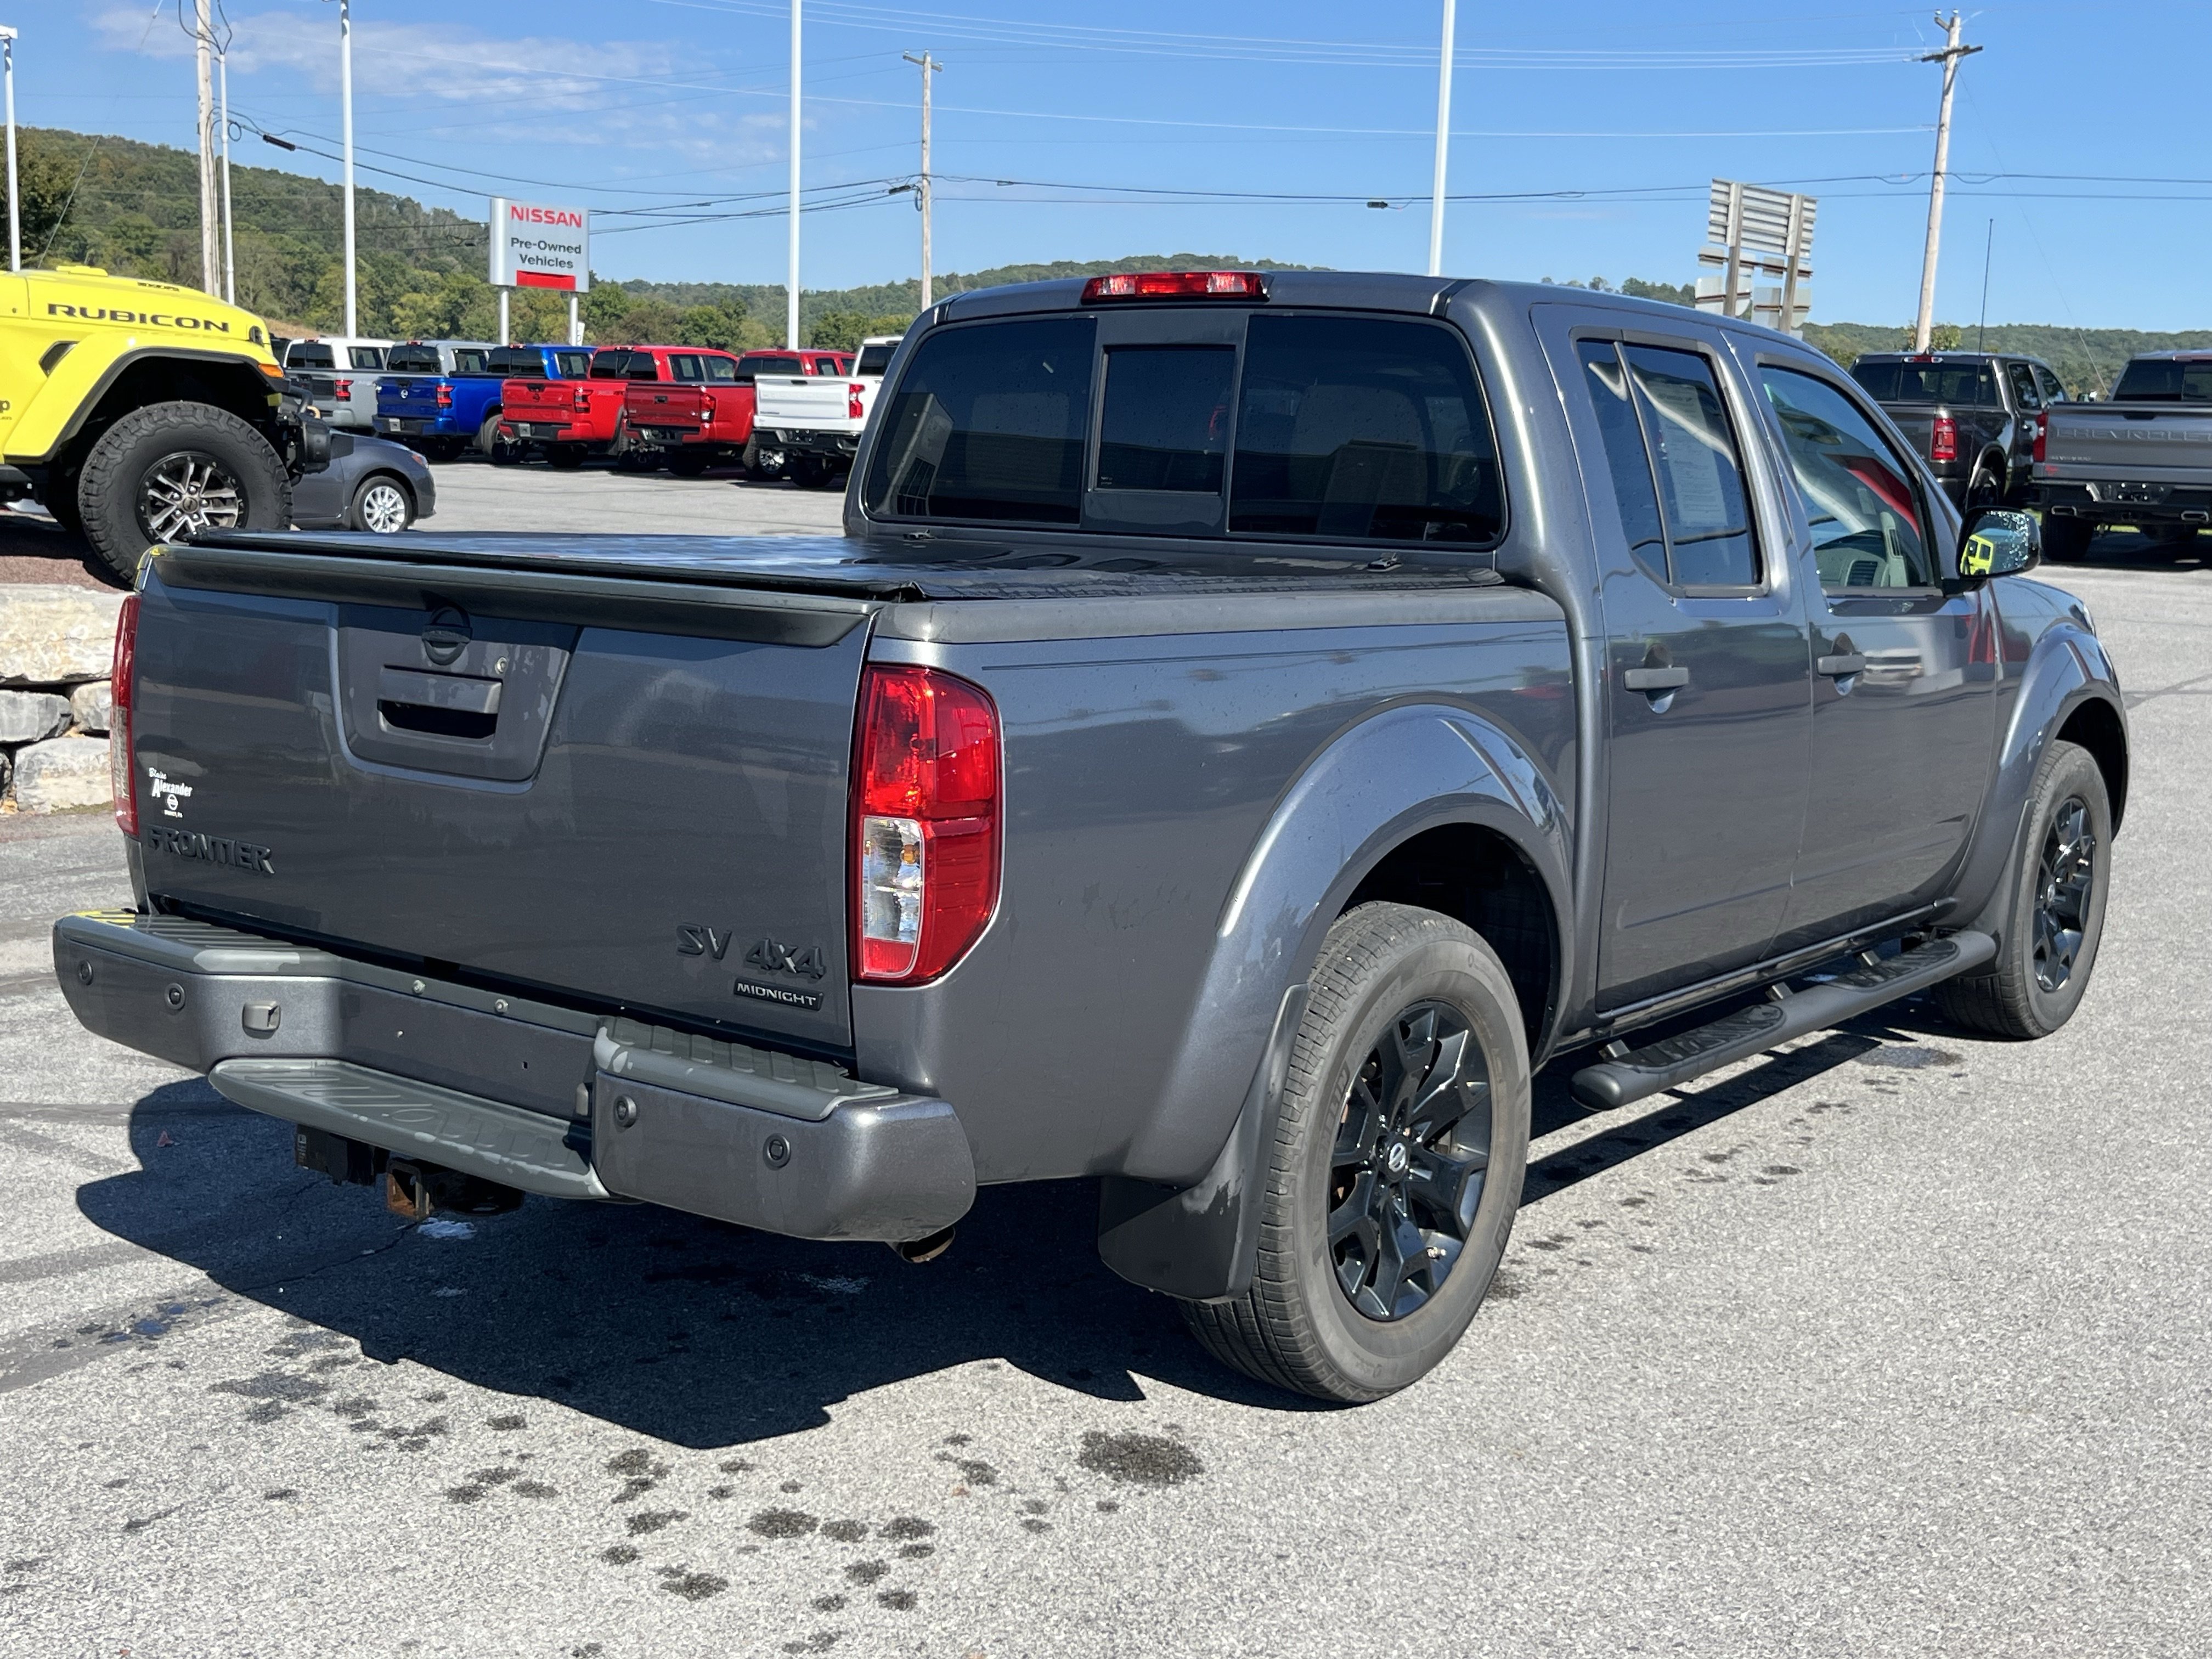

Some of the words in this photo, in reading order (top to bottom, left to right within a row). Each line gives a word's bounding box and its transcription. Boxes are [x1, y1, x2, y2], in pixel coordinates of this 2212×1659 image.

[510, 205, 582, 228] NISSAN
[511, 237, 582, 255] Pre-Owned
[520, 253, 573, 268] Vehicles
[48, 303, 229, 333] RUBICON
[2057, 427, 2212, 441] CHEVROLE
[151, 778, 193, 798] Alexander
[148, 824, 275, 874] FRONTIER
[676, 923, 732, 961] SV
[737, 983, 816, 1006] MIDNIGHT
